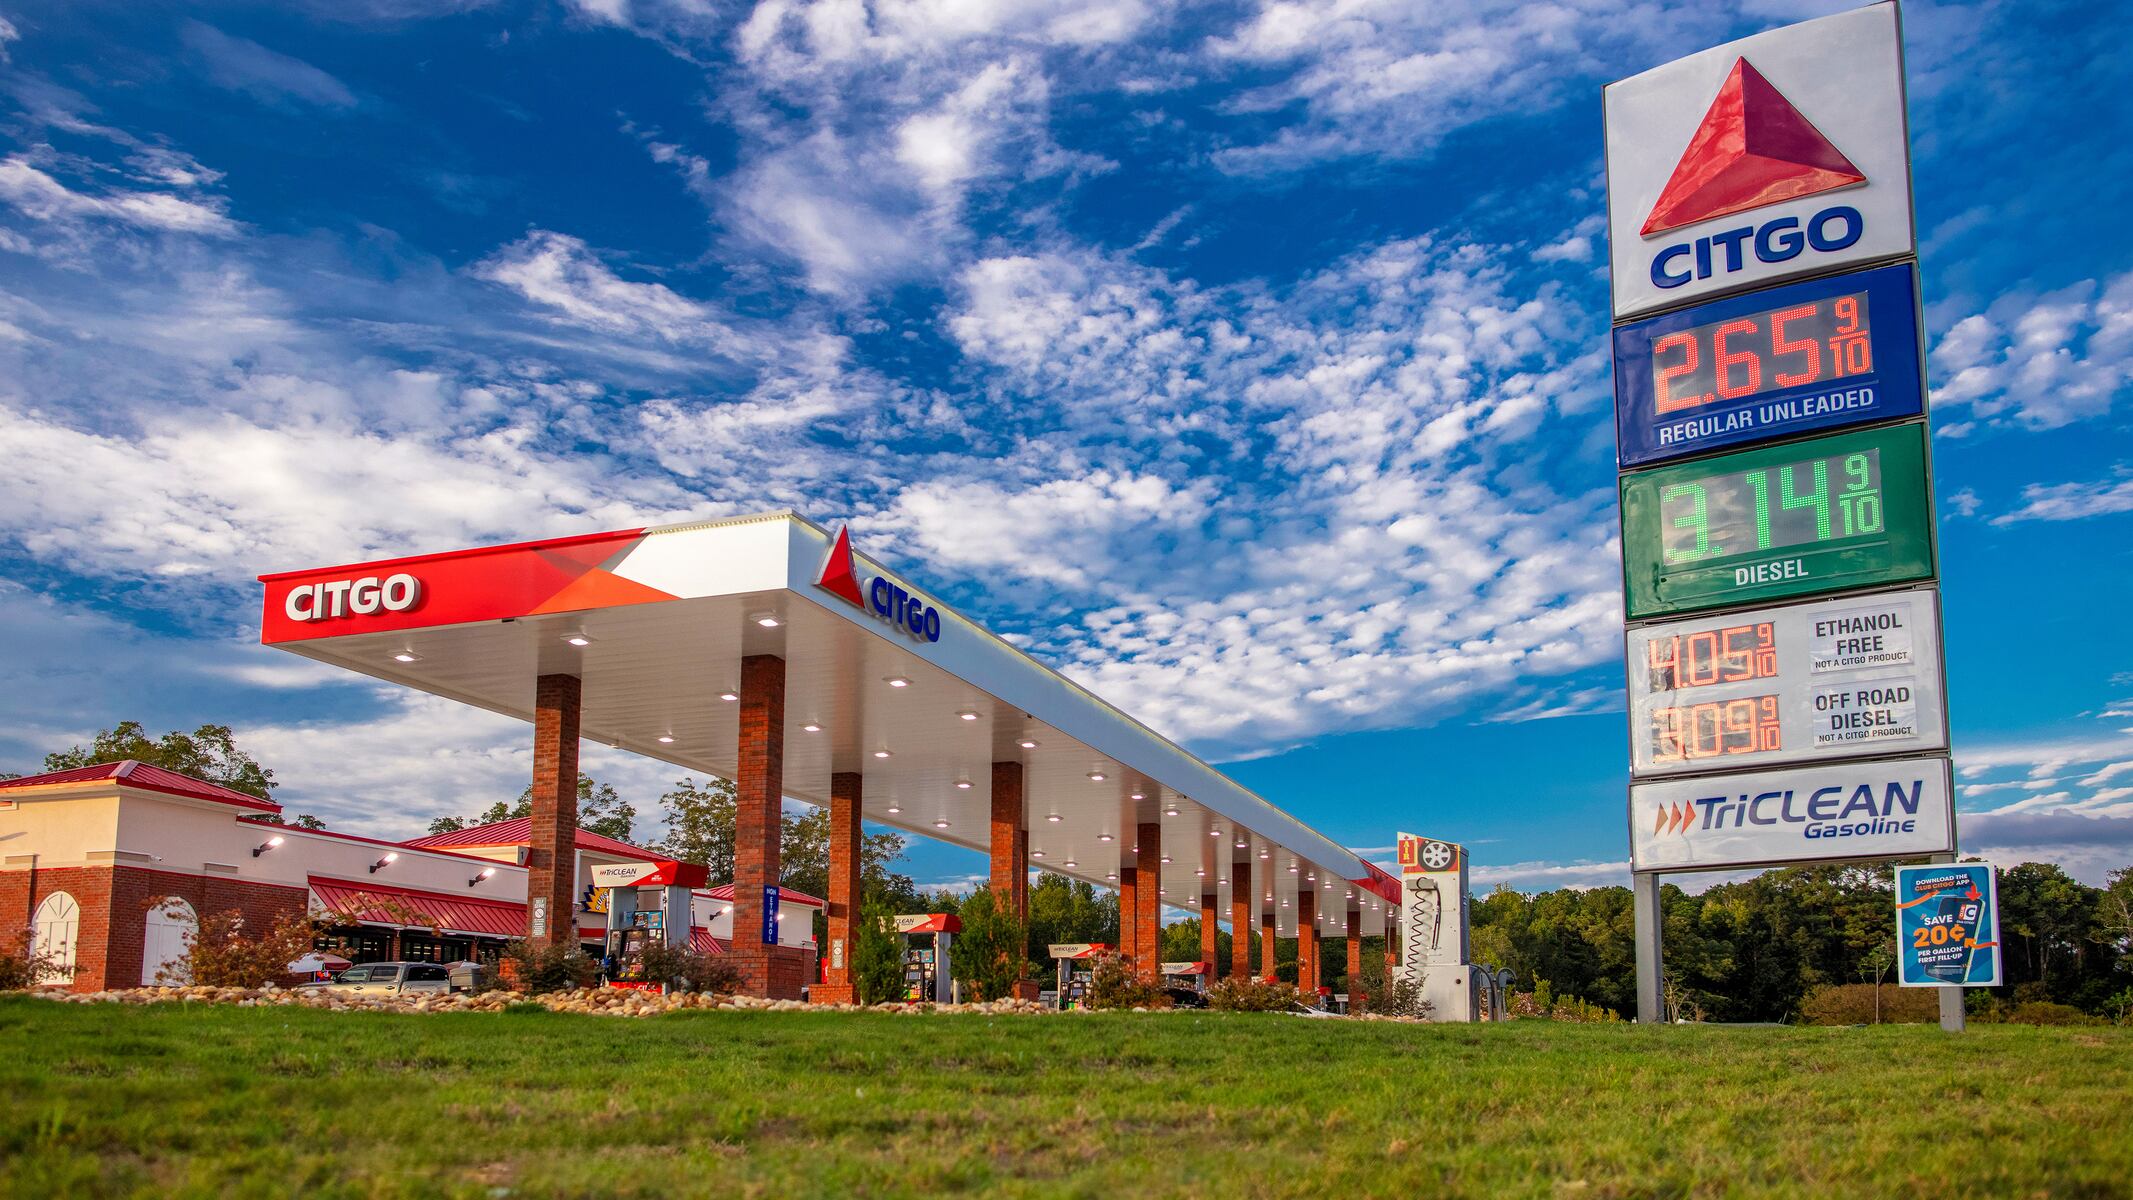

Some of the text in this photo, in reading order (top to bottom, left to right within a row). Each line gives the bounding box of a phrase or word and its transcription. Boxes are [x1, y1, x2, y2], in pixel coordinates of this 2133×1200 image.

[1650, 205, 1863, 289] CITGO
[1655, 304, 1821, 414] 2.65
[1659, 388, 1874, 445] REGULAR UNLEADED
[1663, 460, 1831, 562] 3.14
[1735, 559, 1808, 586] DIESEL
[285, 573, 419, 622] CITGO
[870, 576, 941, 643] CITGO
[1815, 612, 1903, 638] ETHANOL
[1836, 635, 1884, 655] FREE
[1815, 651, 1908, 669] NOT A CITGO PRODUCT
[1815, 686, 1910, 711] OFF ROAD
[1831, 709, 1897, 730] DIESEL
[1819, 726, 1912, 743] NOT A CITGO PRODUCT
[1695, 780, 1923, 831] TriCLEAN
[1803, 818, 1915, 840] Gasoline
[520, 851, 524, 860] 1
[766, 888, 777, 896] NON
[1915, 875, 1955, 886] DOWNLOAD
[1924, 914, 1953, 926] SAVE
[1913, 924, 1966, 948] 20¢
[1918, 953, 1963, 964] FIRST FILL-UP
